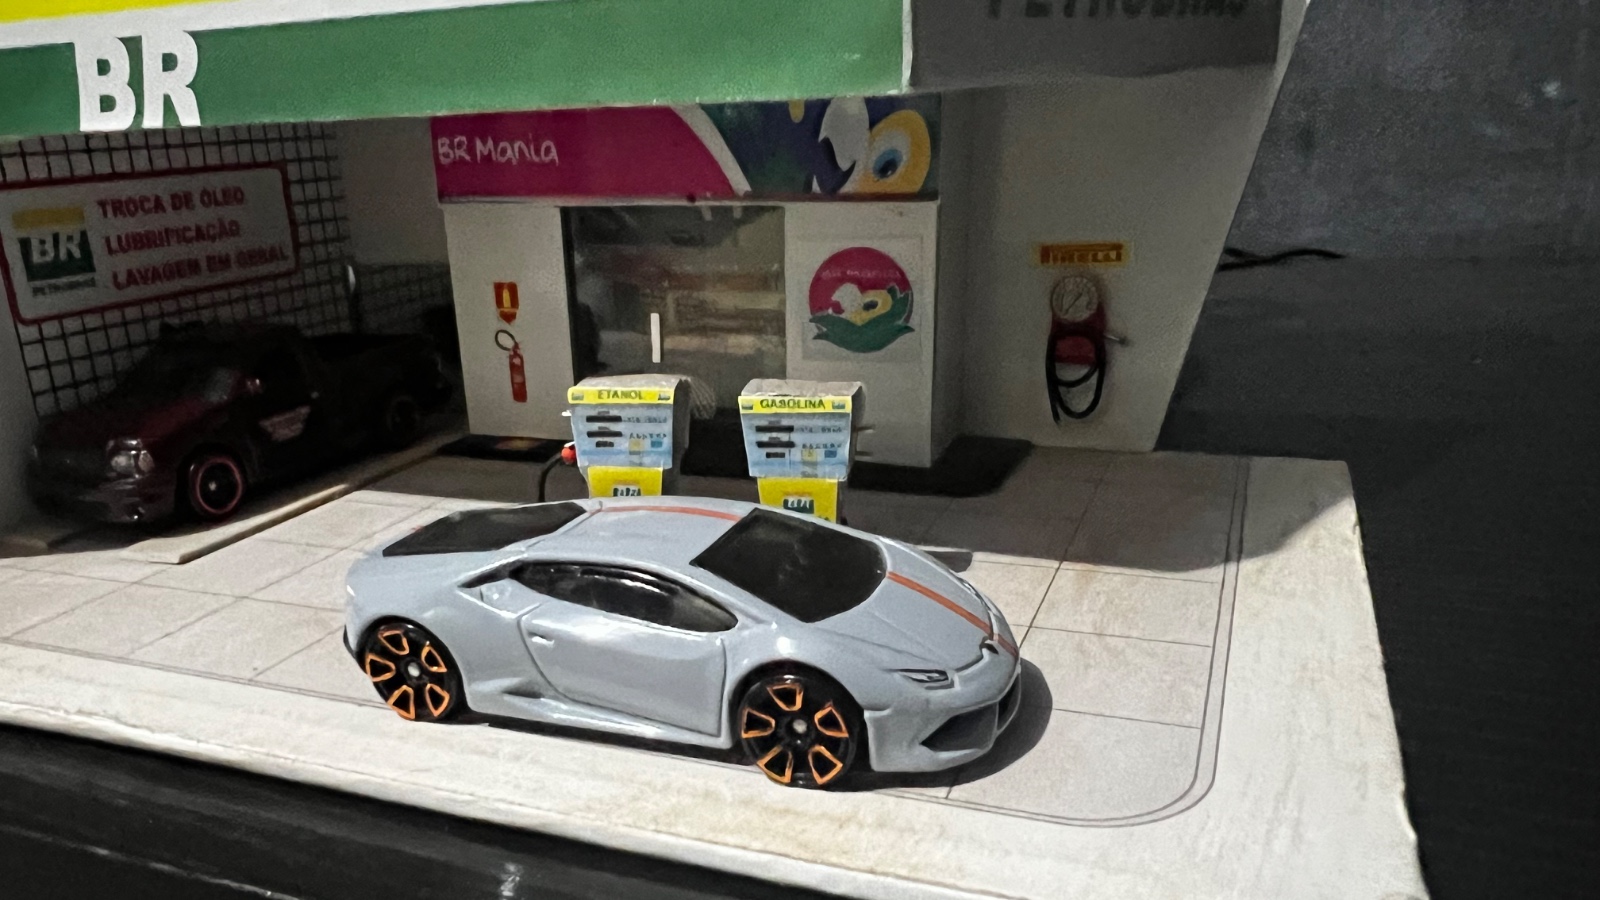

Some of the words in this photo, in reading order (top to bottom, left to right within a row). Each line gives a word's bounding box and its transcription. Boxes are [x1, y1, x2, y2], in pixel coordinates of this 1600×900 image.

[74, 30, 202, 132] BR
[437, 135, 471, 166] BR
[476, 131, 560, 168] Mania
[97, 195, 168, 220] TROCA
[171, 191, 196, 212] DE
[200, 186, 245, 208] ÓLEO
[28, 229, 83, 264] BR
[104, 218, 242, 256] LUBRIFICAÇÃO
[112, 260, 202, 291] LAVAGEM
[206, 252, 232, 273] EM
[236, 244, 291, 270] GERAL
[597, 389, 646, 401] ETANOL
[759, 398, 827, 410] GASOLINA
